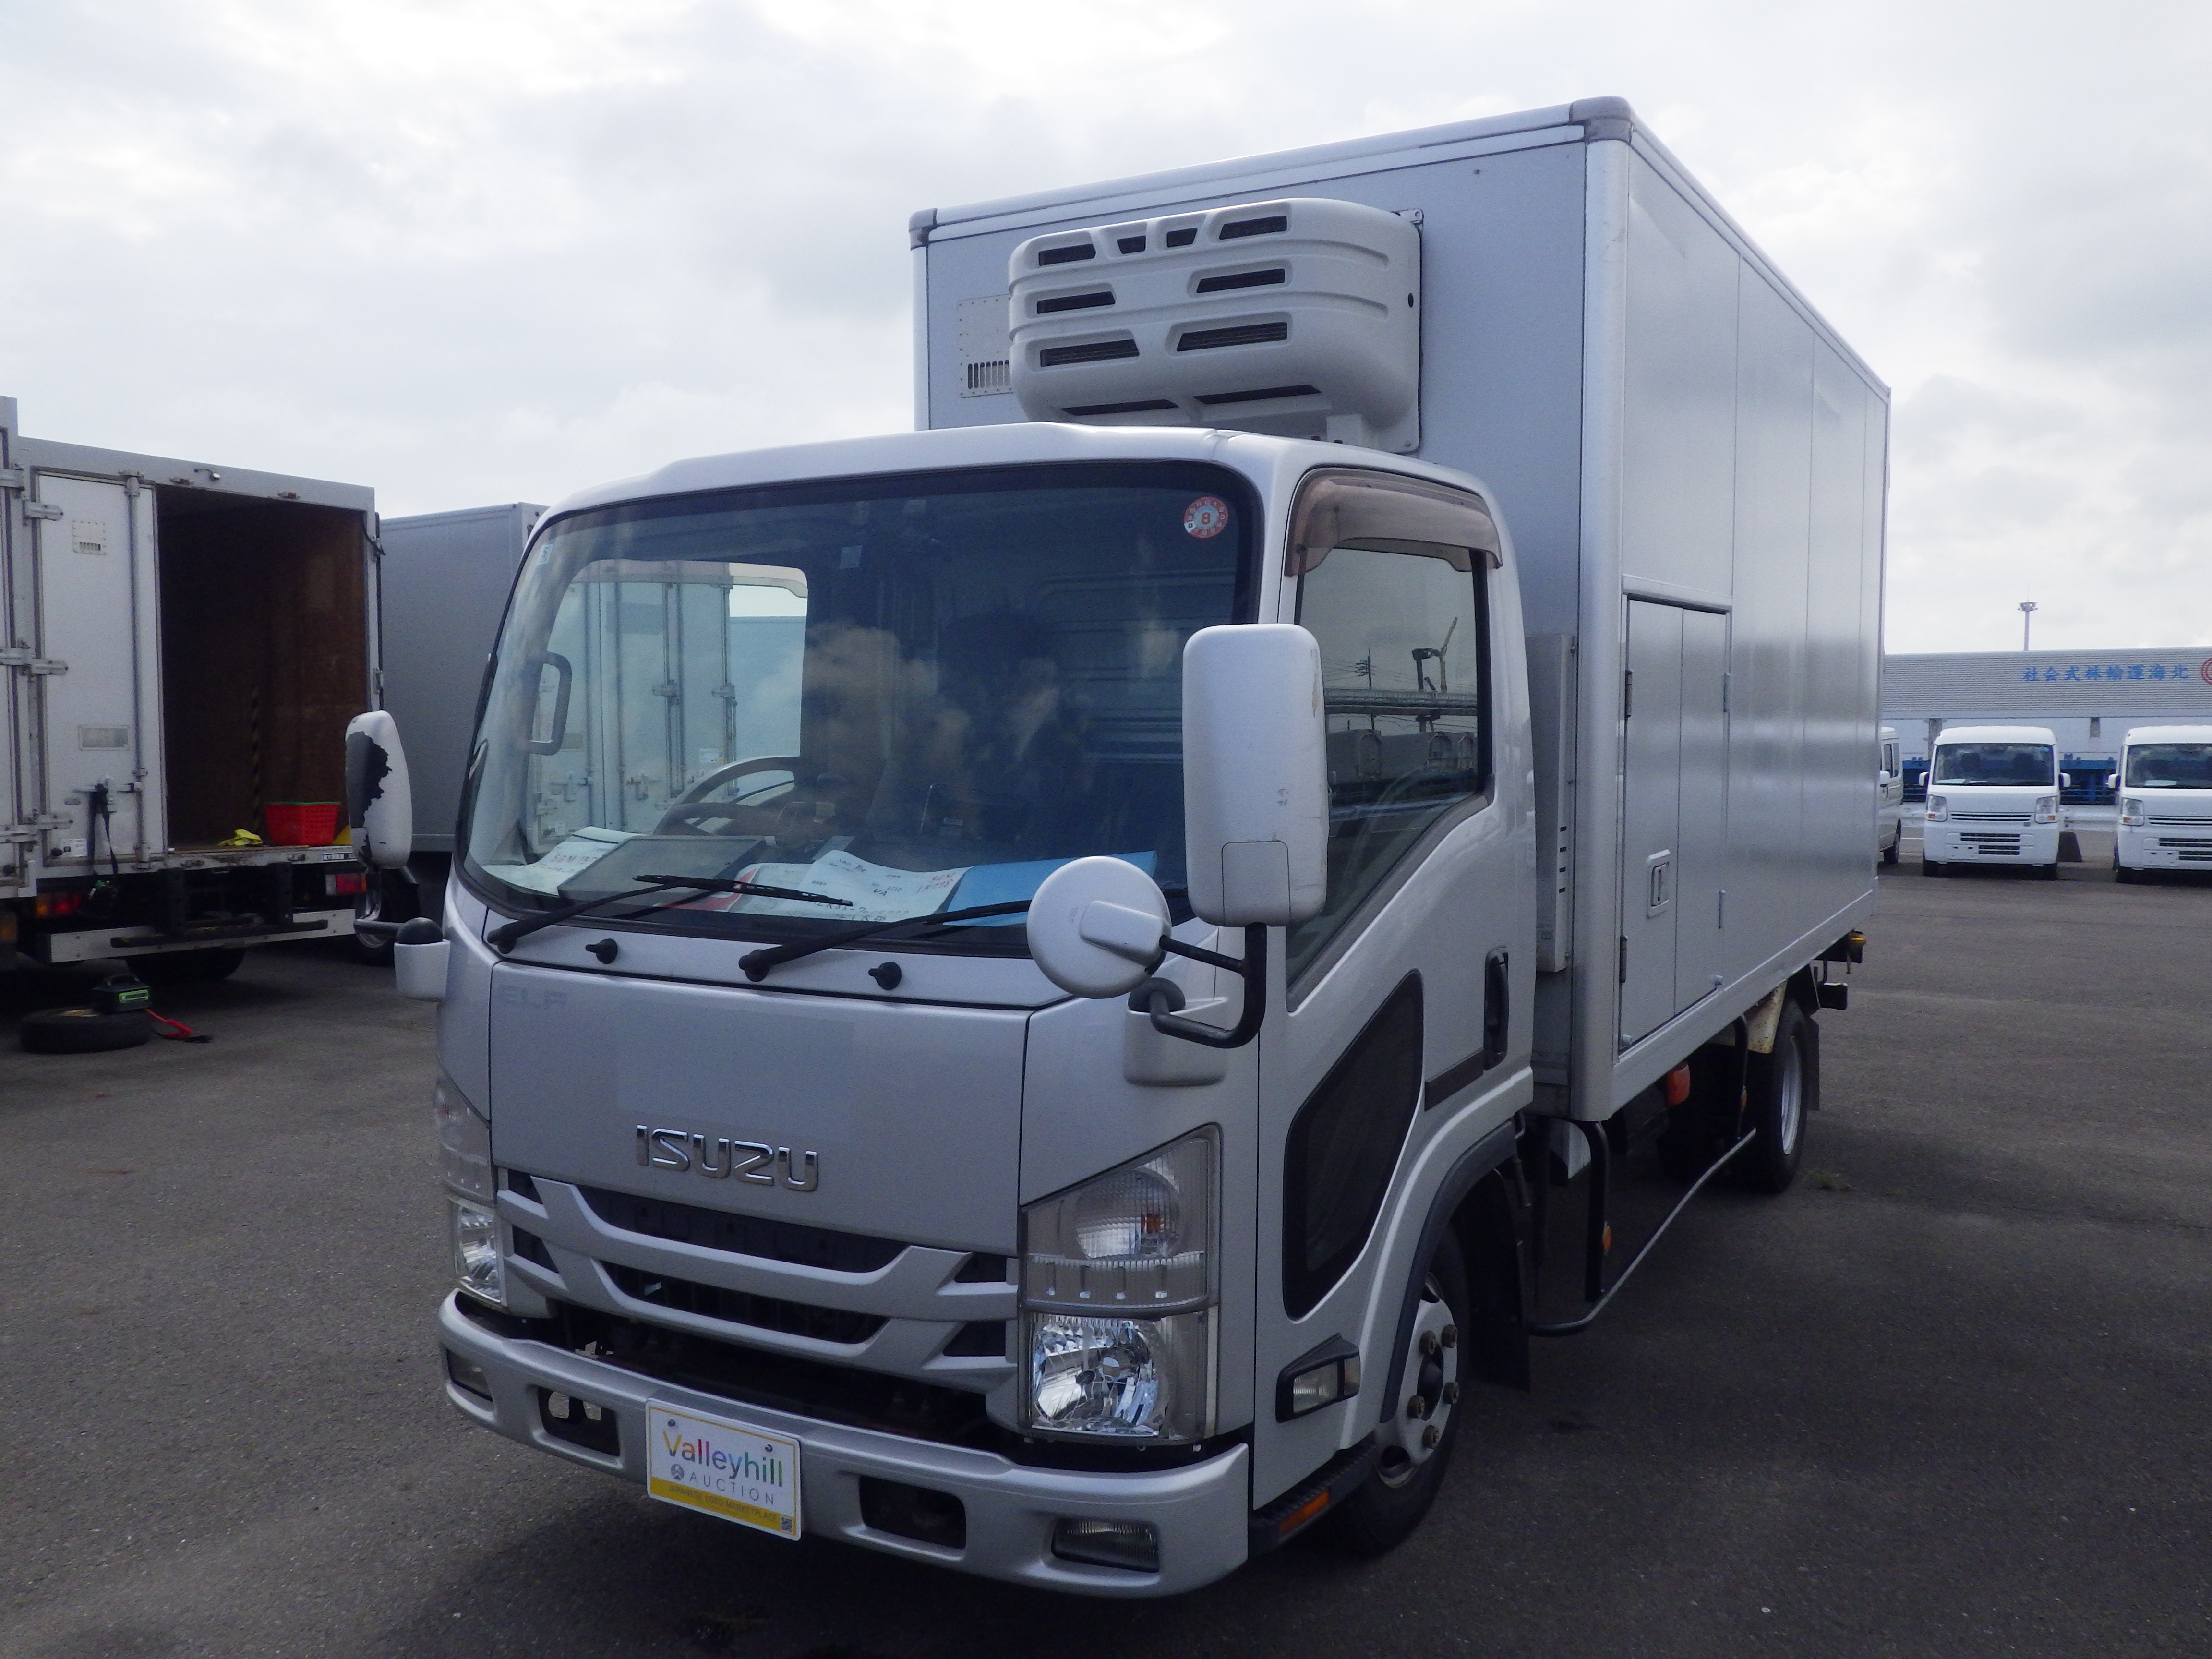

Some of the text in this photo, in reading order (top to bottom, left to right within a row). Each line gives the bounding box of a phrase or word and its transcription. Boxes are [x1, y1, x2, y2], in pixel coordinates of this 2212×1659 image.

[1201, 512, 1211, 524] 8
[636, 1124, 819, 1192] ISUZU
[662, 1430, 782, 1487] Valleyhill
[689, 1471, 774, 1505] AUCTION
